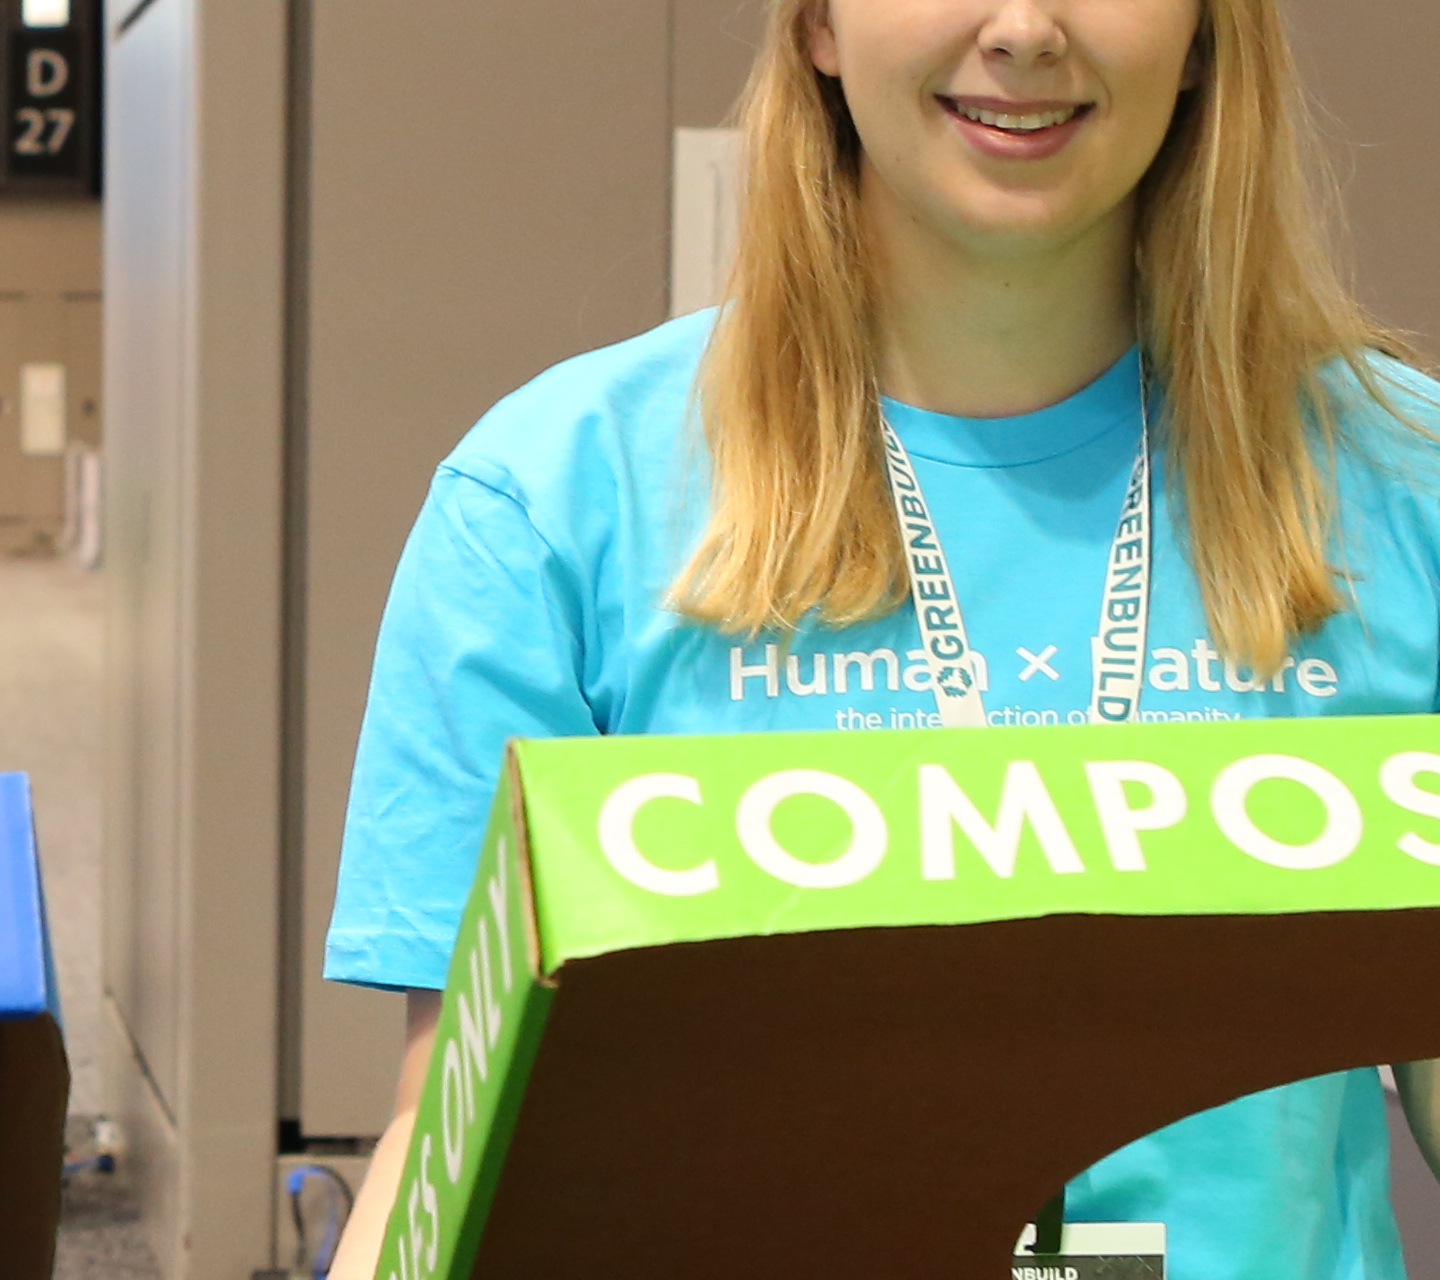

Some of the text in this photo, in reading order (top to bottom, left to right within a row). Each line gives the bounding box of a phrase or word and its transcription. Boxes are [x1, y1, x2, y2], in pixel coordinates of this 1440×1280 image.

[26, 49, 69, 98] D
[15, 108, 75, 156] 27
[1147, 638, 1339, 698] ature
[440, 834, 513, 1186] ONLY
